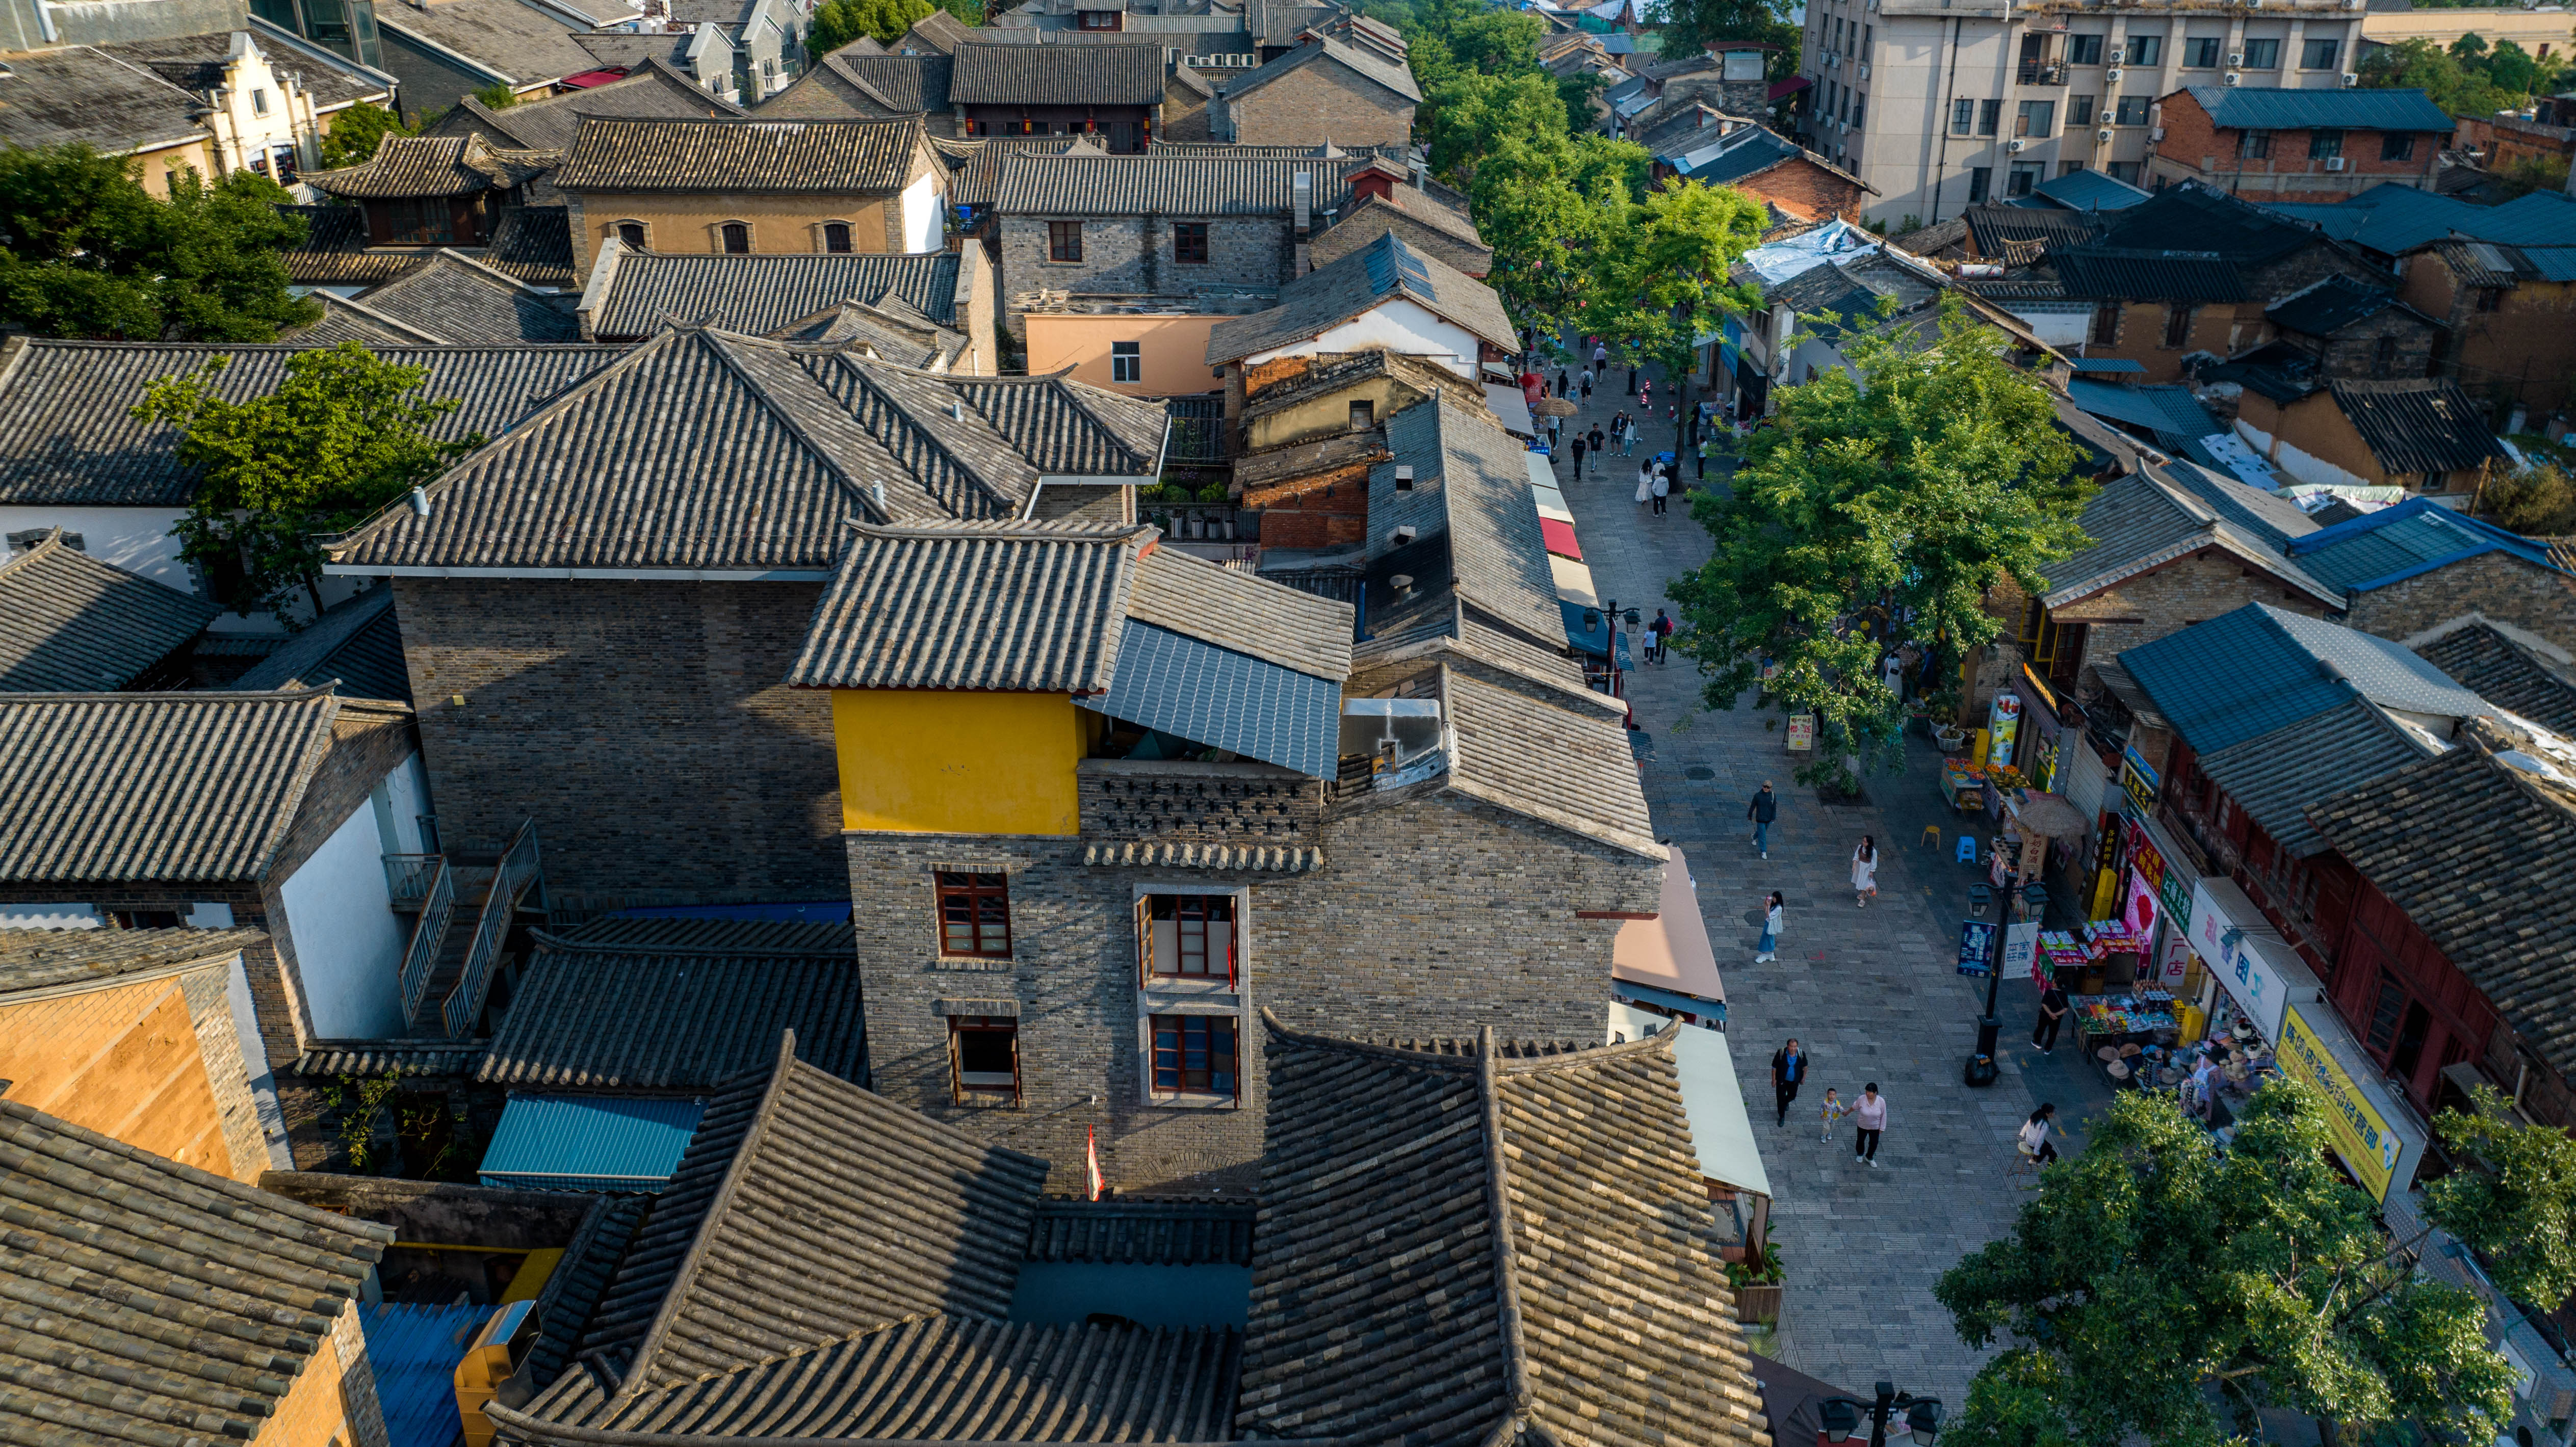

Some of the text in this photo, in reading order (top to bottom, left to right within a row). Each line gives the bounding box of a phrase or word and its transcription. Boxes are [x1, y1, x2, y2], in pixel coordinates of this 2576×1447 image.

[2145, 843, 2161, 869] 云南
[2164, 873, 2192, 919] 云南土特
